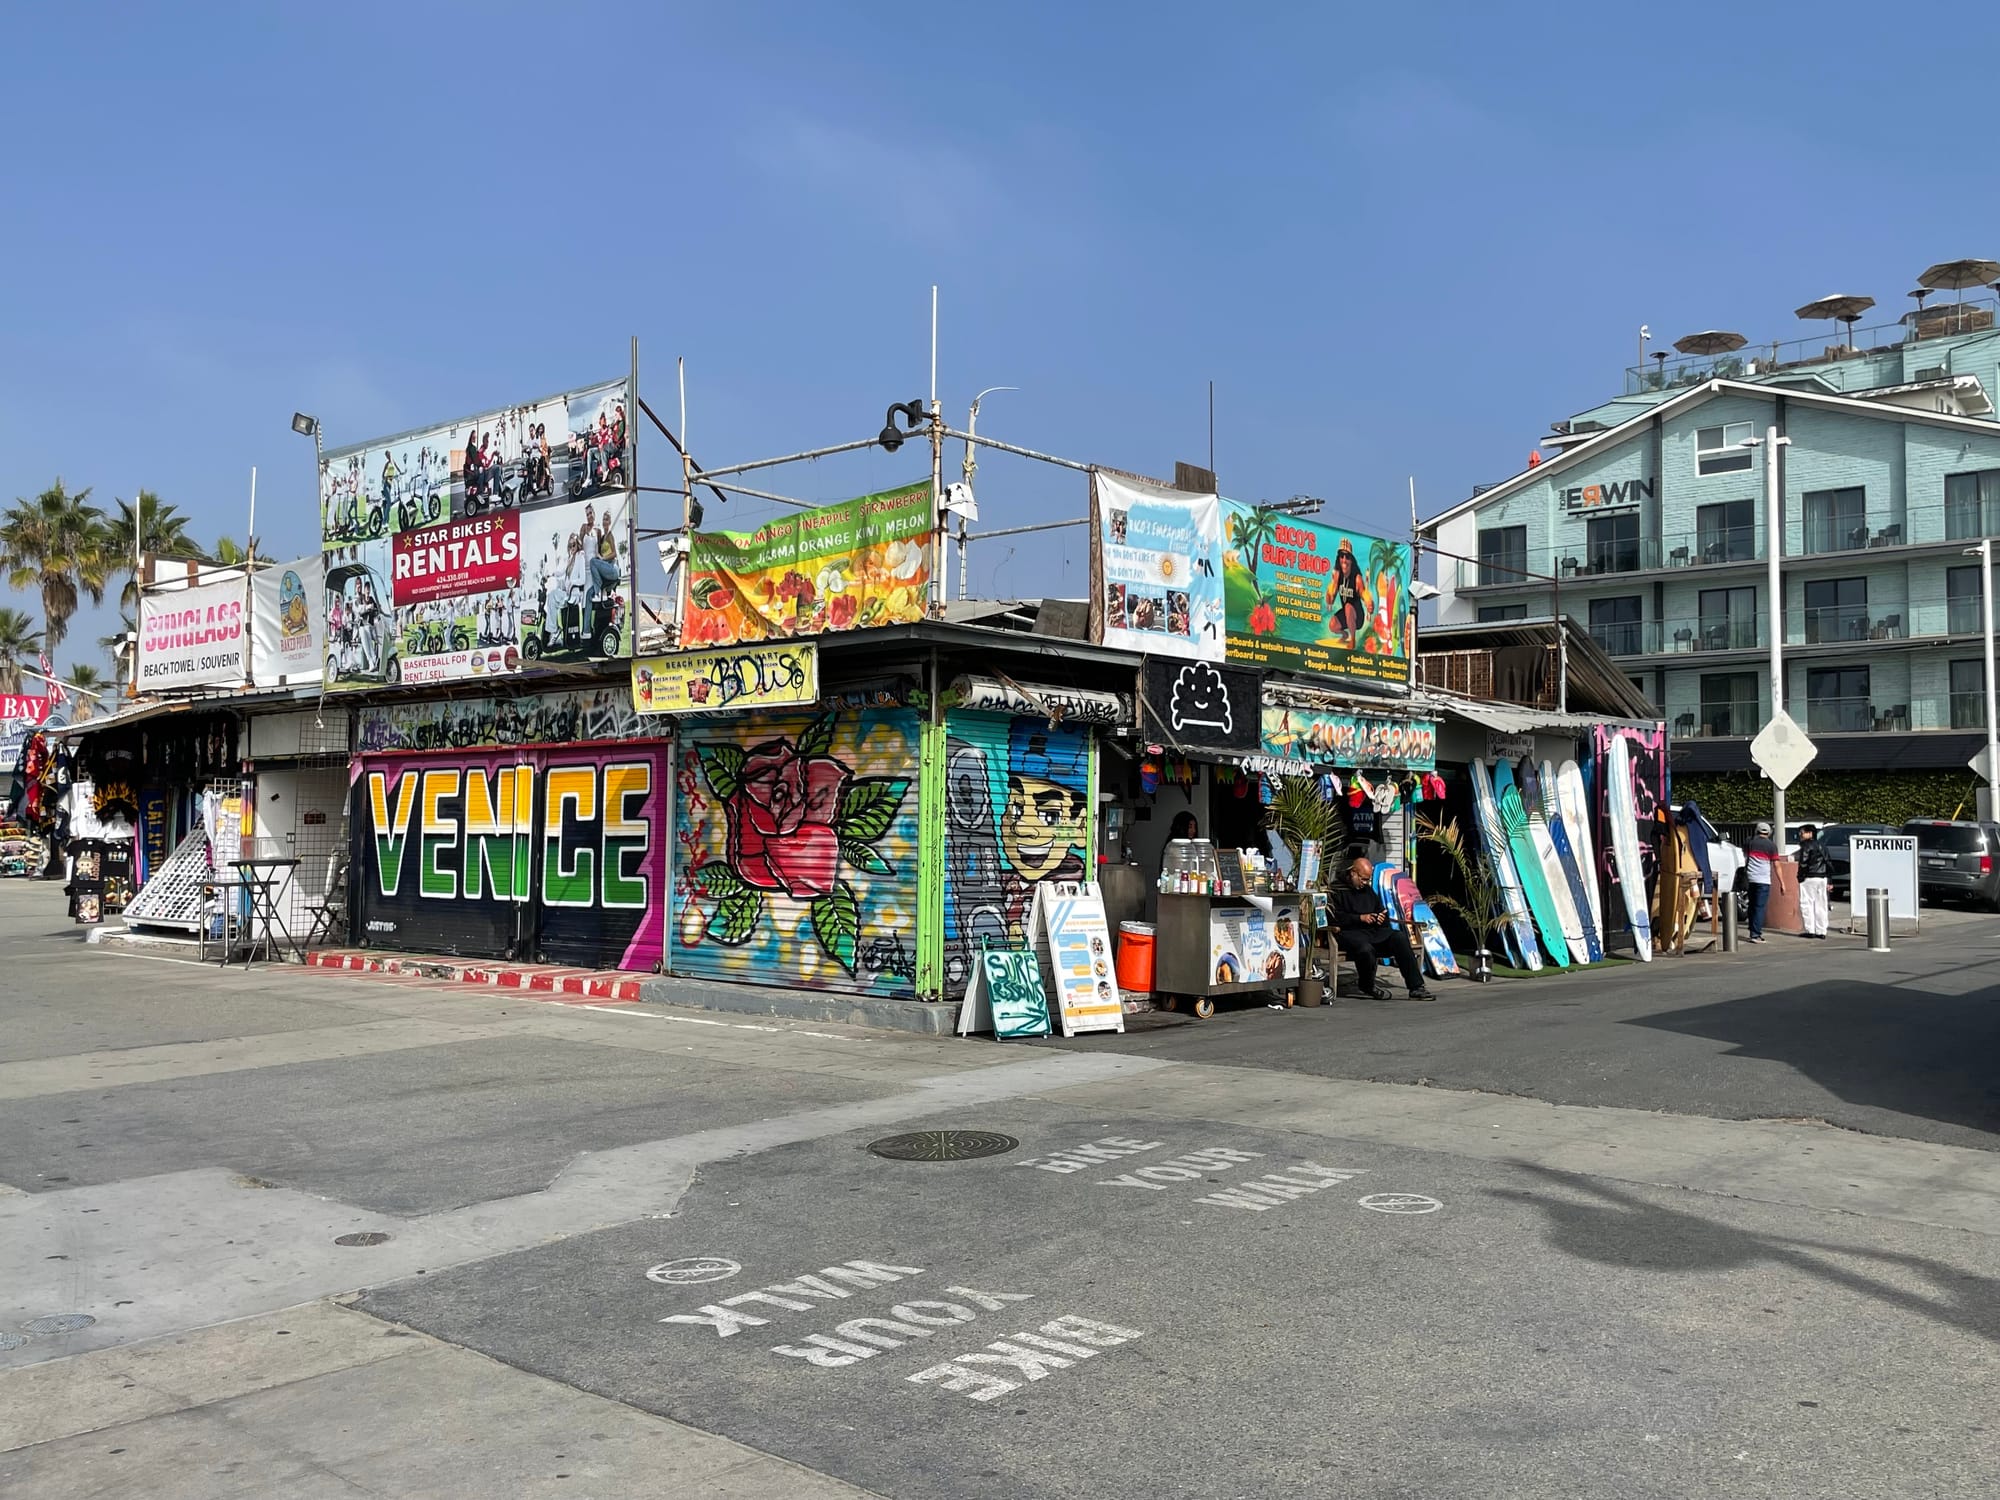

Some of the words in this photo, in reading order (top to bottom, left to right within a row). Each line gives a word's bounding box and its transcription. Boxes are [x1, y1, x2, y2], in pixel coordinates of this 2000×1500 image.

[859, 489, 929, 517] STRAWBERRY
[1567, 478, 1654, 510] ERWIN
[414, 529, 448, 547] STAR
[452, 520, 491, 539] BIKES
[799, 532, 850, 553] ORANGE
[885, 512, 925, 534] MELON
[1275, 524, 1317, 551] RICO'S
[395, 532, 518, 580] RENTALS
[1262, 543, 1297, 568] SURF
[1298, 552, 1331, 576] SHOP
[1276, 571, 1288, 580] YOU
[1307, 578, 1322, 588] STOP
[1276, 594, 1289, 603] YOU
[1290, 597, 1302, 606] CAN
[1303, 600, 1321, 610] LEARN
[1276, 606, 1290, 616] HOW
[1291, 609, 1299, 617] TO
[145, 601, 241, 652] SUNGLASS
[144, 663, 169, 677] BEACH
[170, 659, 195, 674] TOWEL
[201, 652, 240, 670] SOUVENIR
[404, 656, 449, 670] BASKETBALL
[452, 655, 467, 663] FOR
[404, 671, 422, 681] RENT
[430, 670, 447, 679] SELL
[666, 659, 693, 669] BEACH
[4, 698, 44, 718] BAY
[1353, 813, 1374, 821] ATM
[368, 764, 651, 908] VENICE
[1856, 839, 1913, 851] PARKING
[1014, 1136, 1166, 1174] BIKE
[1096, 1147, 1268, 1190] YOUR
[1192, 1160, 1371, 1211] WALK
[658, 1259, 926, 1338] WALK
[769, 1285, 1035, 1367] YOUR
[905, 1314, 1145, 1402] BIKE
